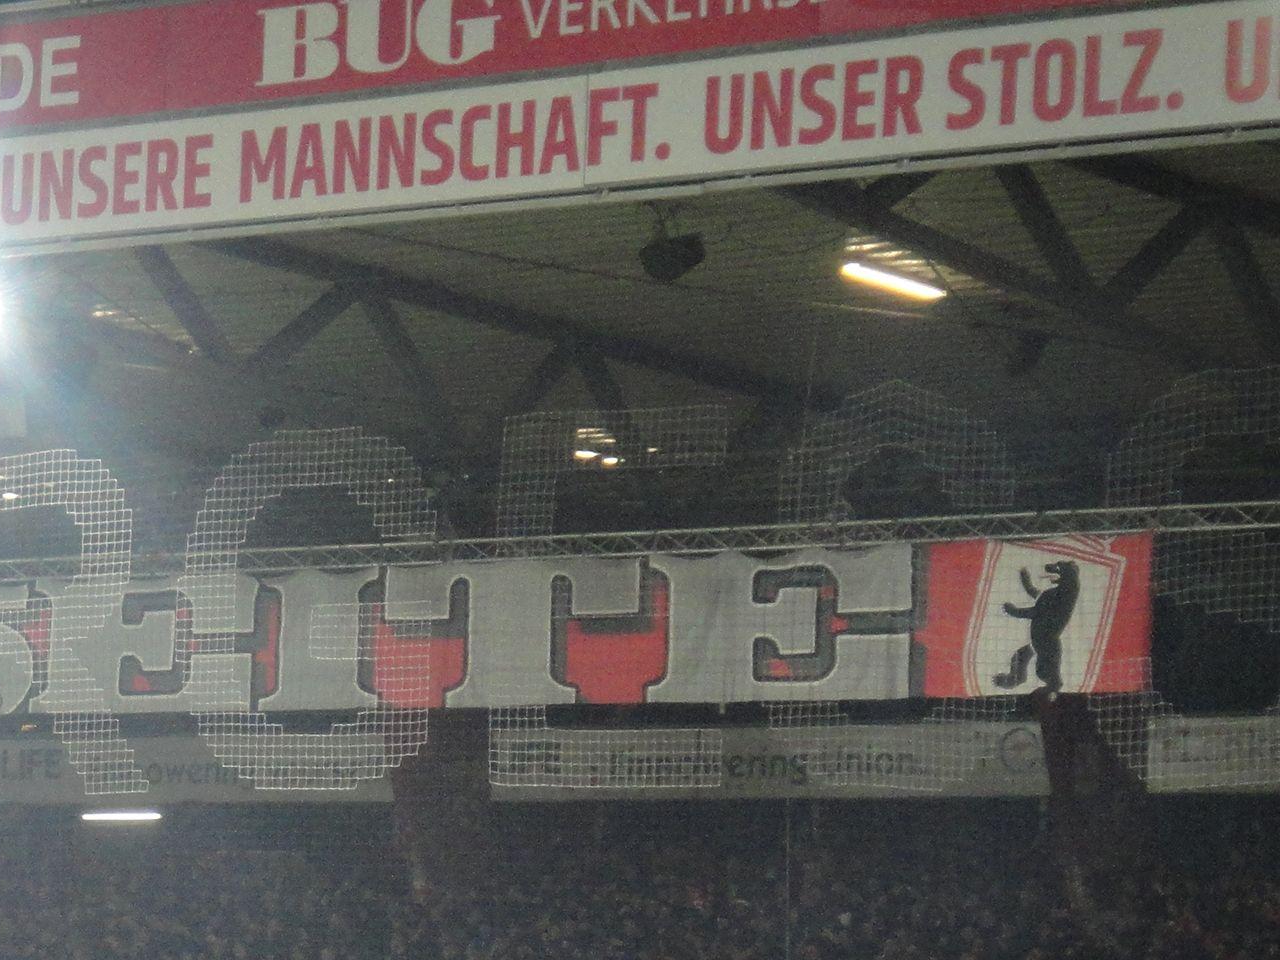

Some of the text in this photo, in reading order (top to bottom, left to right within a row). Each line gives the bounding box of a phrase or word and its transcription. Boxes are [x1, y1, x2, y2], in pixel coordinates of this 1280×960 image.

[255, 0, 501, 86] BUG
[1, 135, 213, 224] UNSERE
[239, 83, 671, 203] MANNSCHAFT.
[704, 55, 922, 153] UNSER
[946, 29, 1184, 131] STOLZ.
